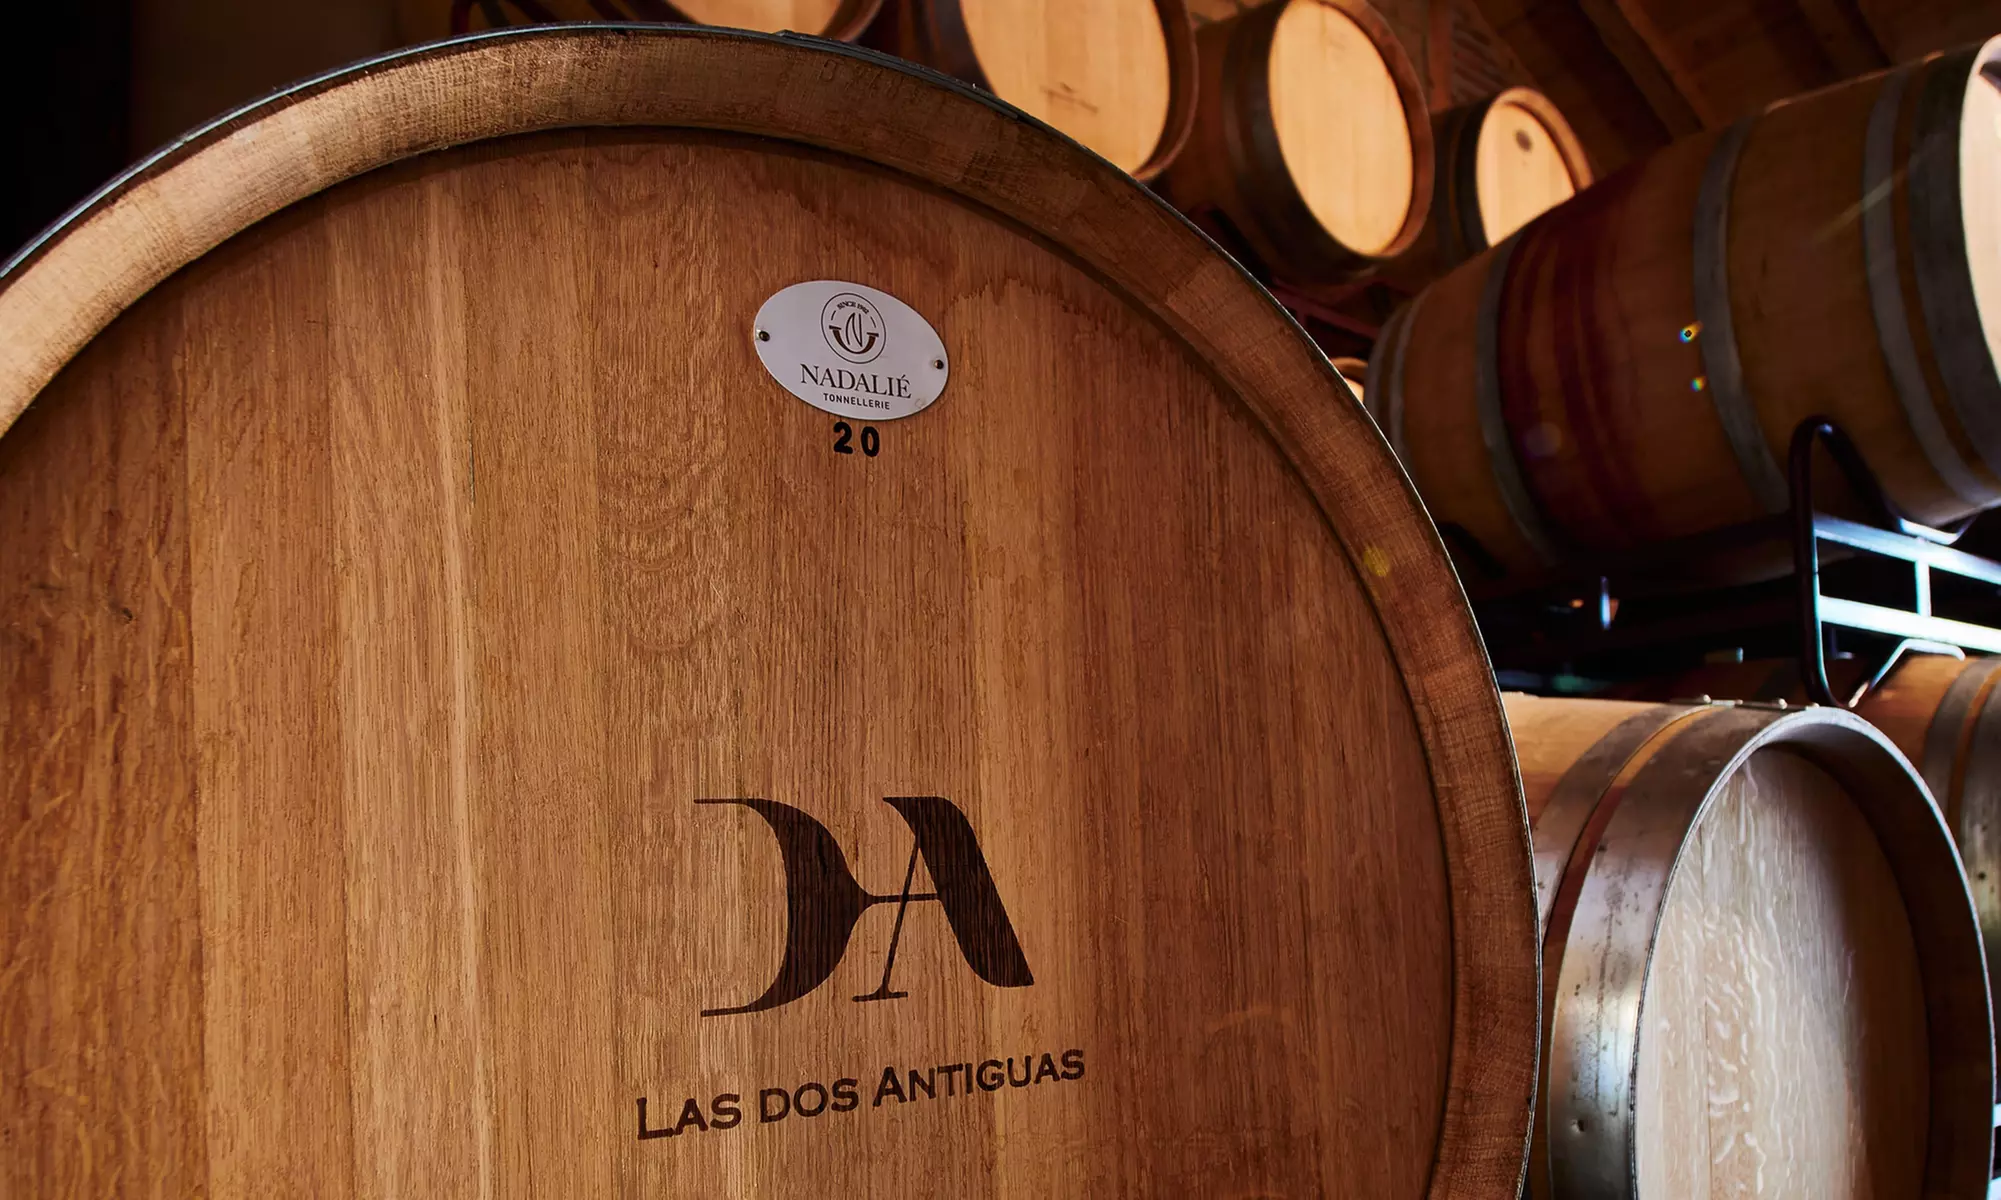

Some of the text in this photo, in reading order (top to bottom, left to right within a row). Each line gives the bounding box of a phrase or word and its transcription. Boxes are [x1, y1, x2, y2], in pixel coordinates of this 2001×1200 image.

[837, 300, 856, 310] SINCE
[800, 363, 912, 399] NADALIÉ
[823, 392, 891, 410] TONNELLERIE
[833, 421, 880, 457] 20
[637, 1048, 1086, 1140] LAS DOS ANTIGUAS
